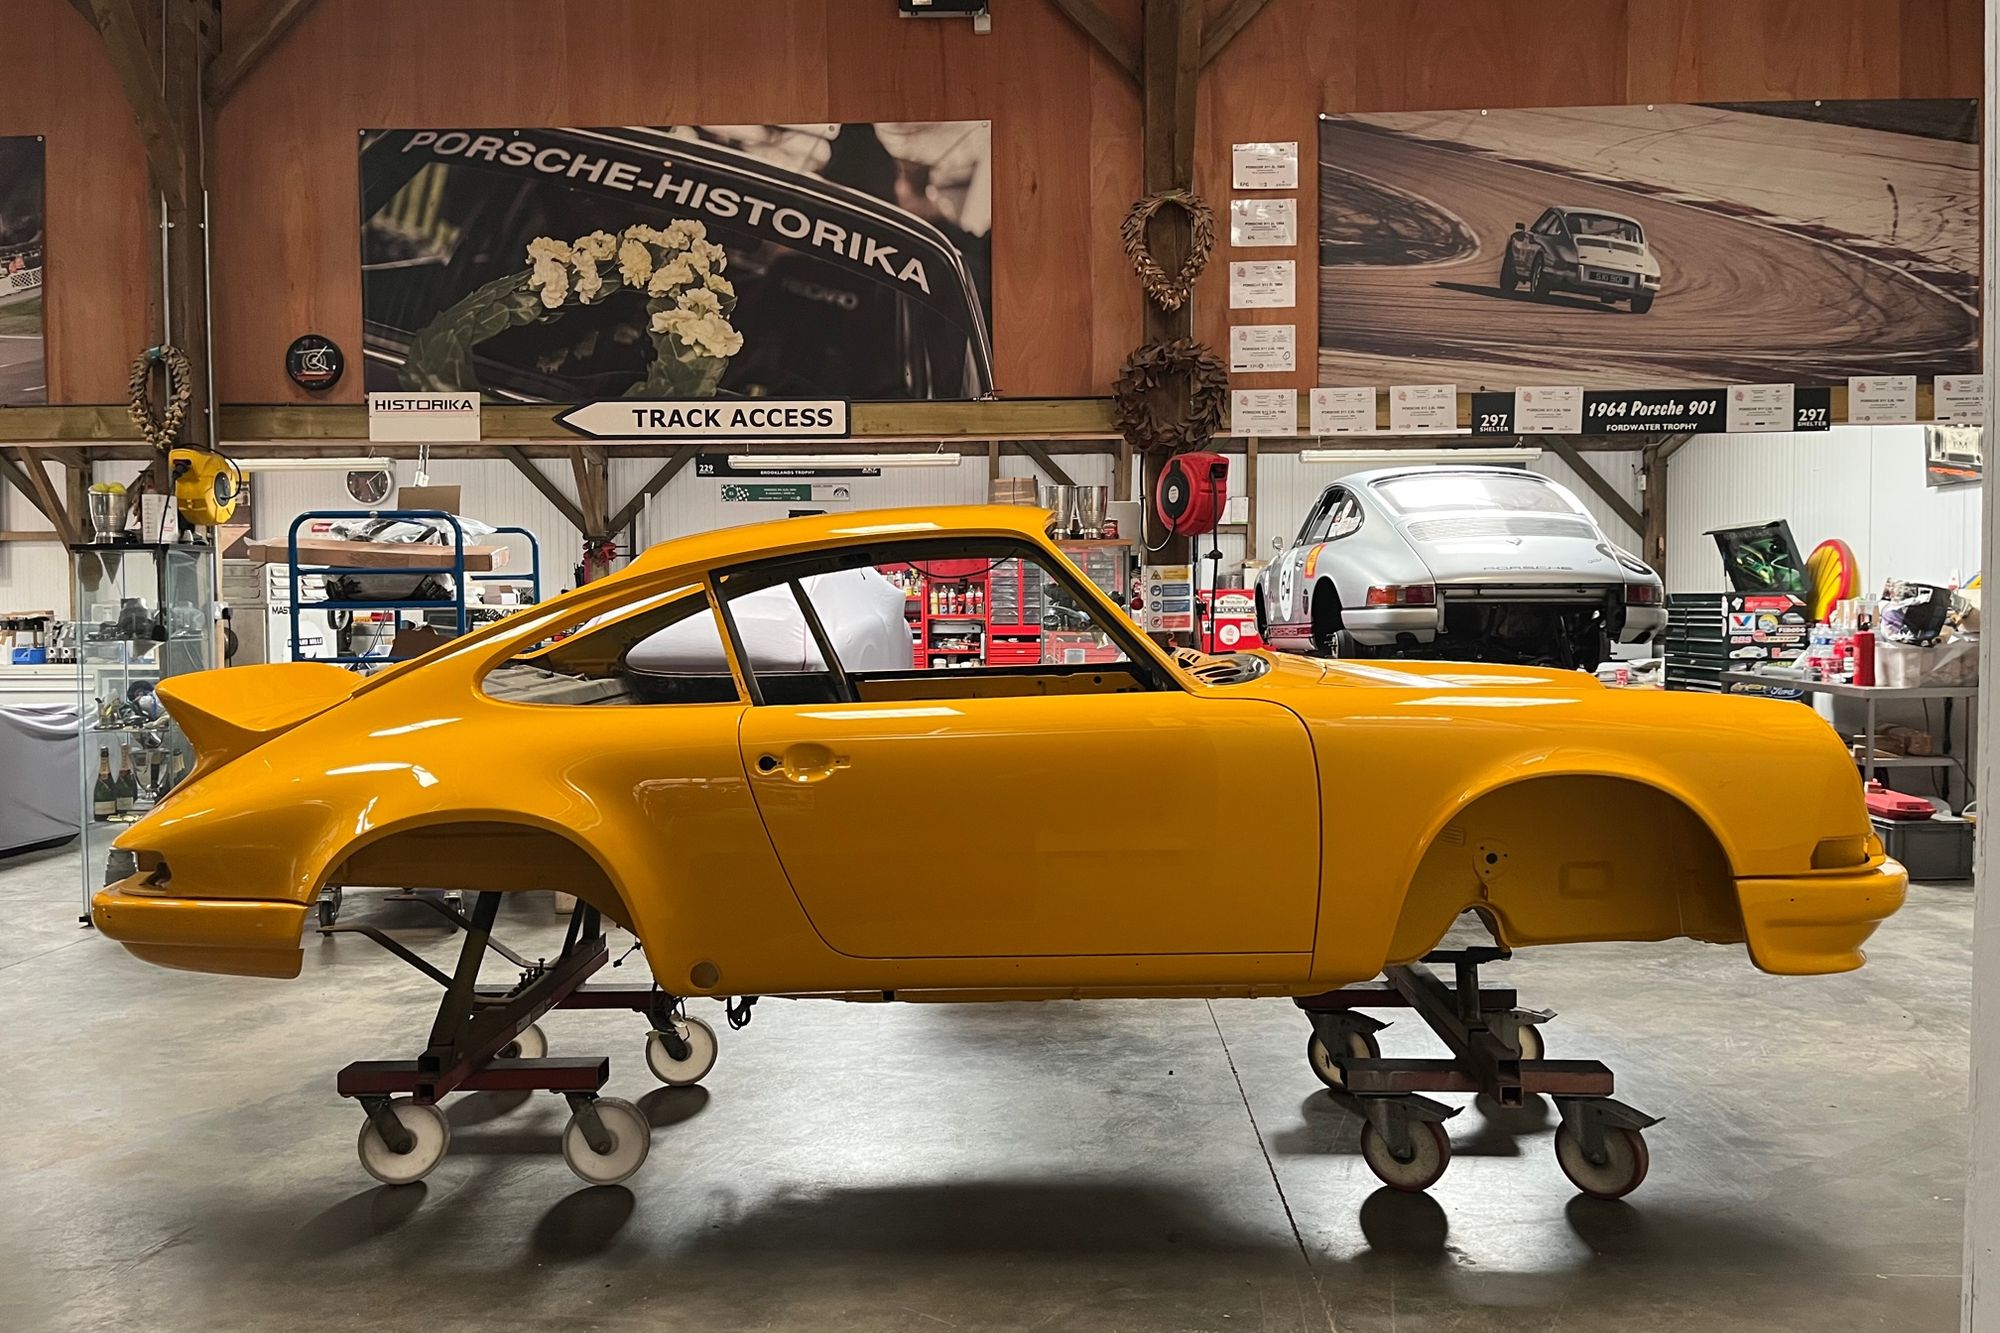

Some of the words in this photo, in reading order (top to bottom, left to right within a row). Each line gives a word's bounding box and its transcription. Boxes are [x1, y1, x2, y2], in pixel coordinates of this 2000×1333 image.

[402, 131, 931, 295] PORSCHE-HISTORIKA
[374, 399, 474, 411] HISTORIKA
[1588, 403, 1626, 417] 1964
[1630, 400, 1684, 416] Porsche
[1688, 400, 1717, 415] 901
[632, 408, 721, 428] TRACK
[731, 407, 834, 428] ACCESS
[1480, 414, 1508, 426] 297
[1798, 408, 1826, 422] 297
[1606, 424, 1661, 432] FORDWATER
[1663, 423, 1698, 431] TROPHY
[699, 464, 714, 472] 229
[1770, 686, 1795, 695] Ford
